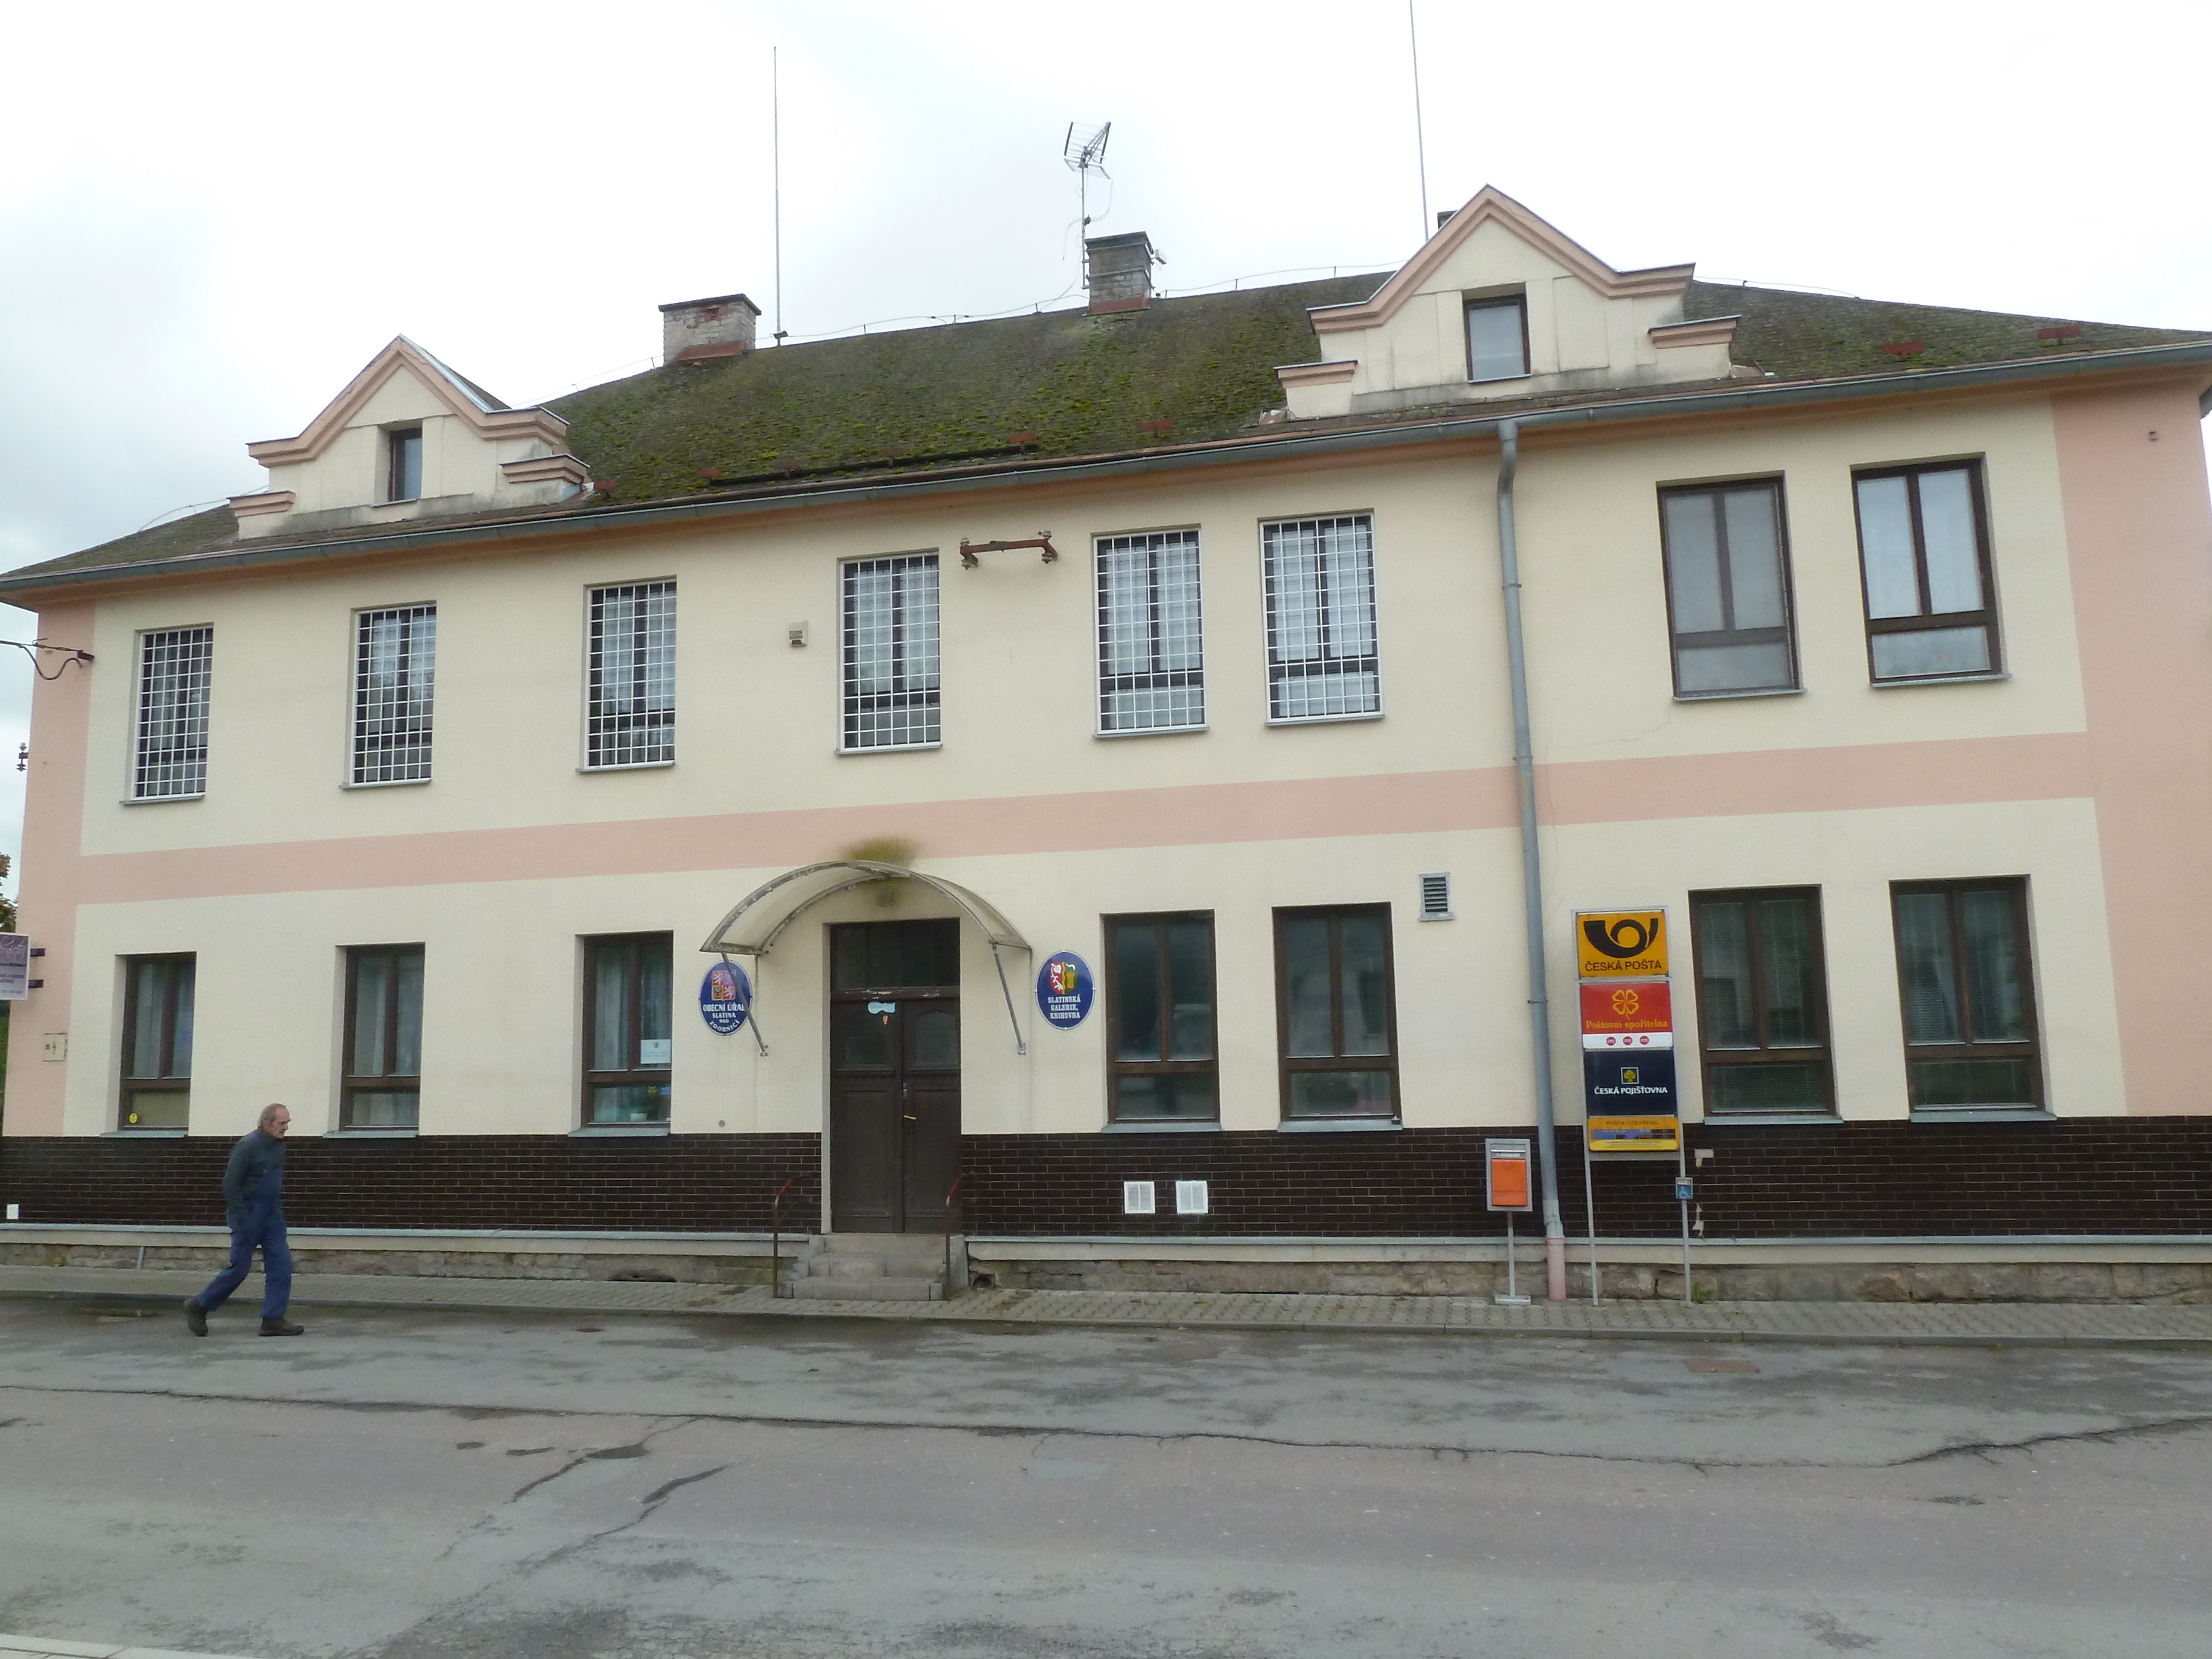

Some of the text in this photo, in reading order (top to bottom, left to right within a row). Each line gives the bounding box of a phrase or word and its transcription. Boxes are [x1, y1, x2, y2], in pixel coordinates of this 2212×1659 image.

[1585, 959, 1662, 972] ČESKÁ POŠTA
[1048, 994, 1081, 1004] SLATINSKÁ
[703, 1002, 726, 1012] OBECNÍ
[709, 1019, 741, 1032] ZDOBNICÍ
[1586, 1019, 1668, 1030] Poštovní spořitelna
[1594, 1086, 1668, 1095] ČESKÁ POJIŠŤOVNA
